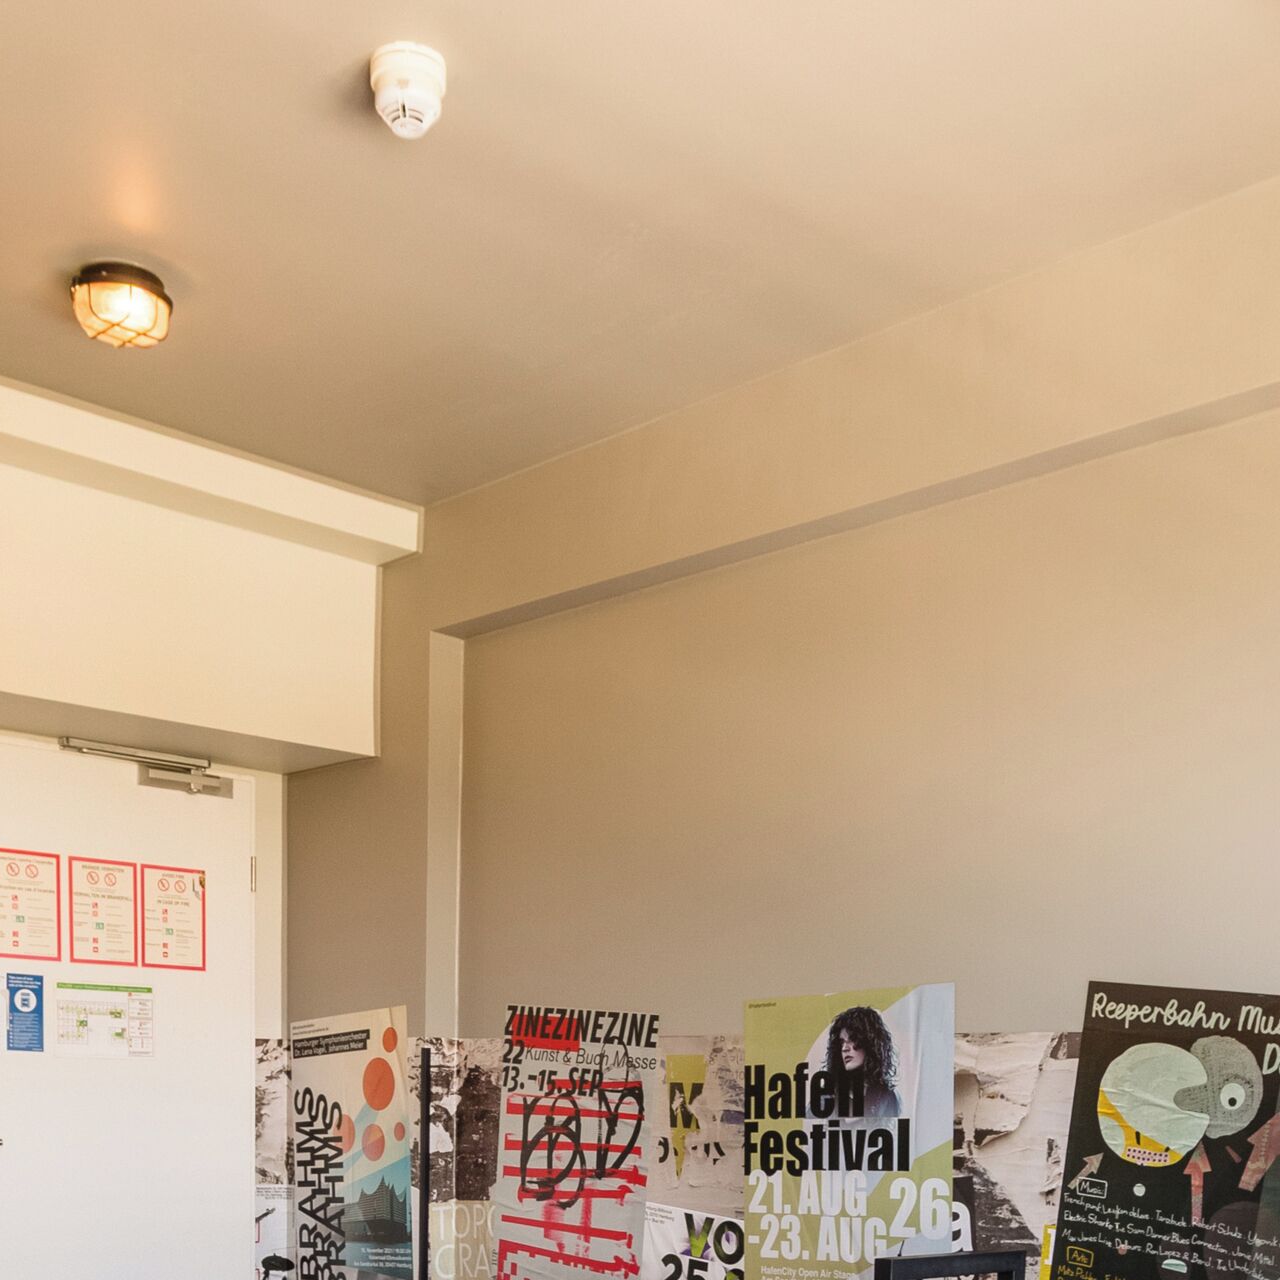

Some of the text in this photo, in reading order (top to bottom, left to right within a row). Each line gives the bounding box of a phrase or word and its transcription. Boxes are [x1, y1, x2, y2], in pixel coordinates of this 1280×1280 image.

[504, 1004, 659, 1048] ZINEZINEZINE
[1092, 991, 1230, 1031] Reeperbahn
[502, 1039, 524, 1063] 22
[525, 1046, 558, 1063] Kunst
[562, 1048, 572, 1064] &
[613, 1050, 657, 1070] Messe
[744, 1062, 865, 1120] Hafen
[745, 1118, 910, 1177] Festival
[295, 1087, 318, 1280] BRAHMS
[748, 1170, 867, 1218] 21. AUG
[889, 1178, 950, 1242] 26
[818, 1216, 890, 1264] AUG
[798, 1267, 818, 1280] Open
